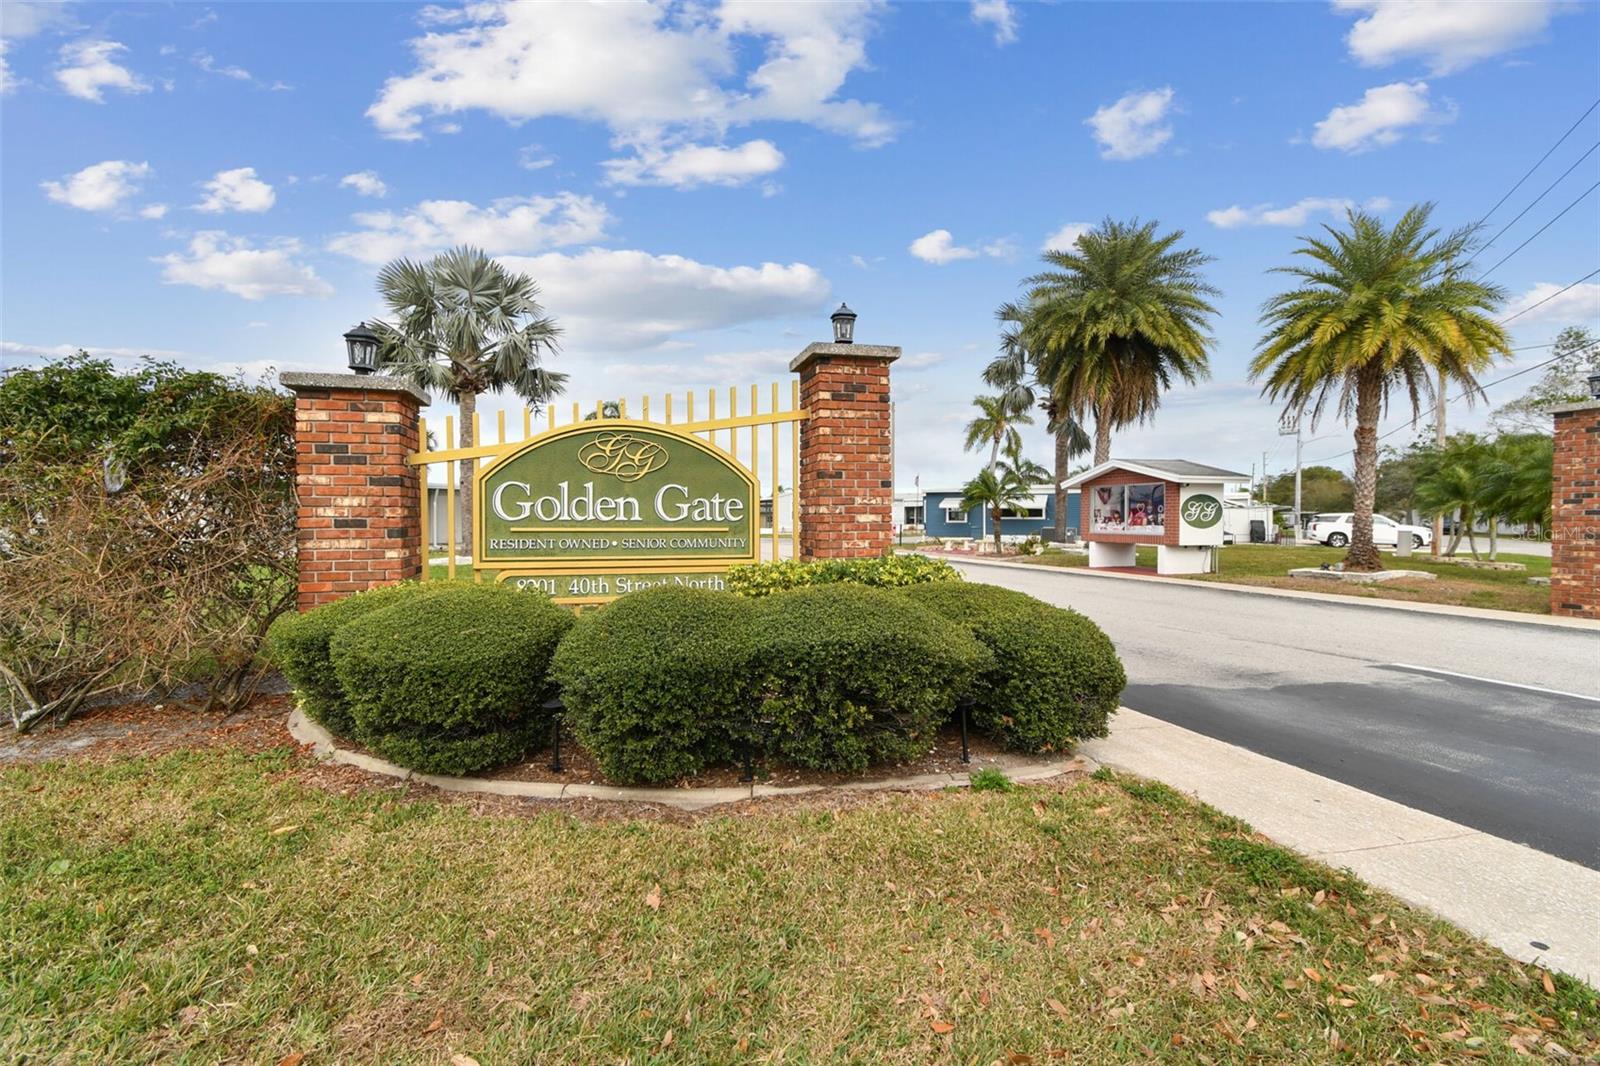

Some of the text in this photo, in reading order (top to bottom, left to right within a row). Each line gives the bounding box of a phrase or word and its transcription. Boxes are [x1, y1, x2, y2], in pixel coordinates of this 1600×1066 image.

[492, 481, 744, 522] Golden Gate
[490, 538, 747, 550] RESIDENT OWNED SENIOR COMMUNITY
[568, 577, 609, 594] 40th
[674, 575, 724, 591] North
